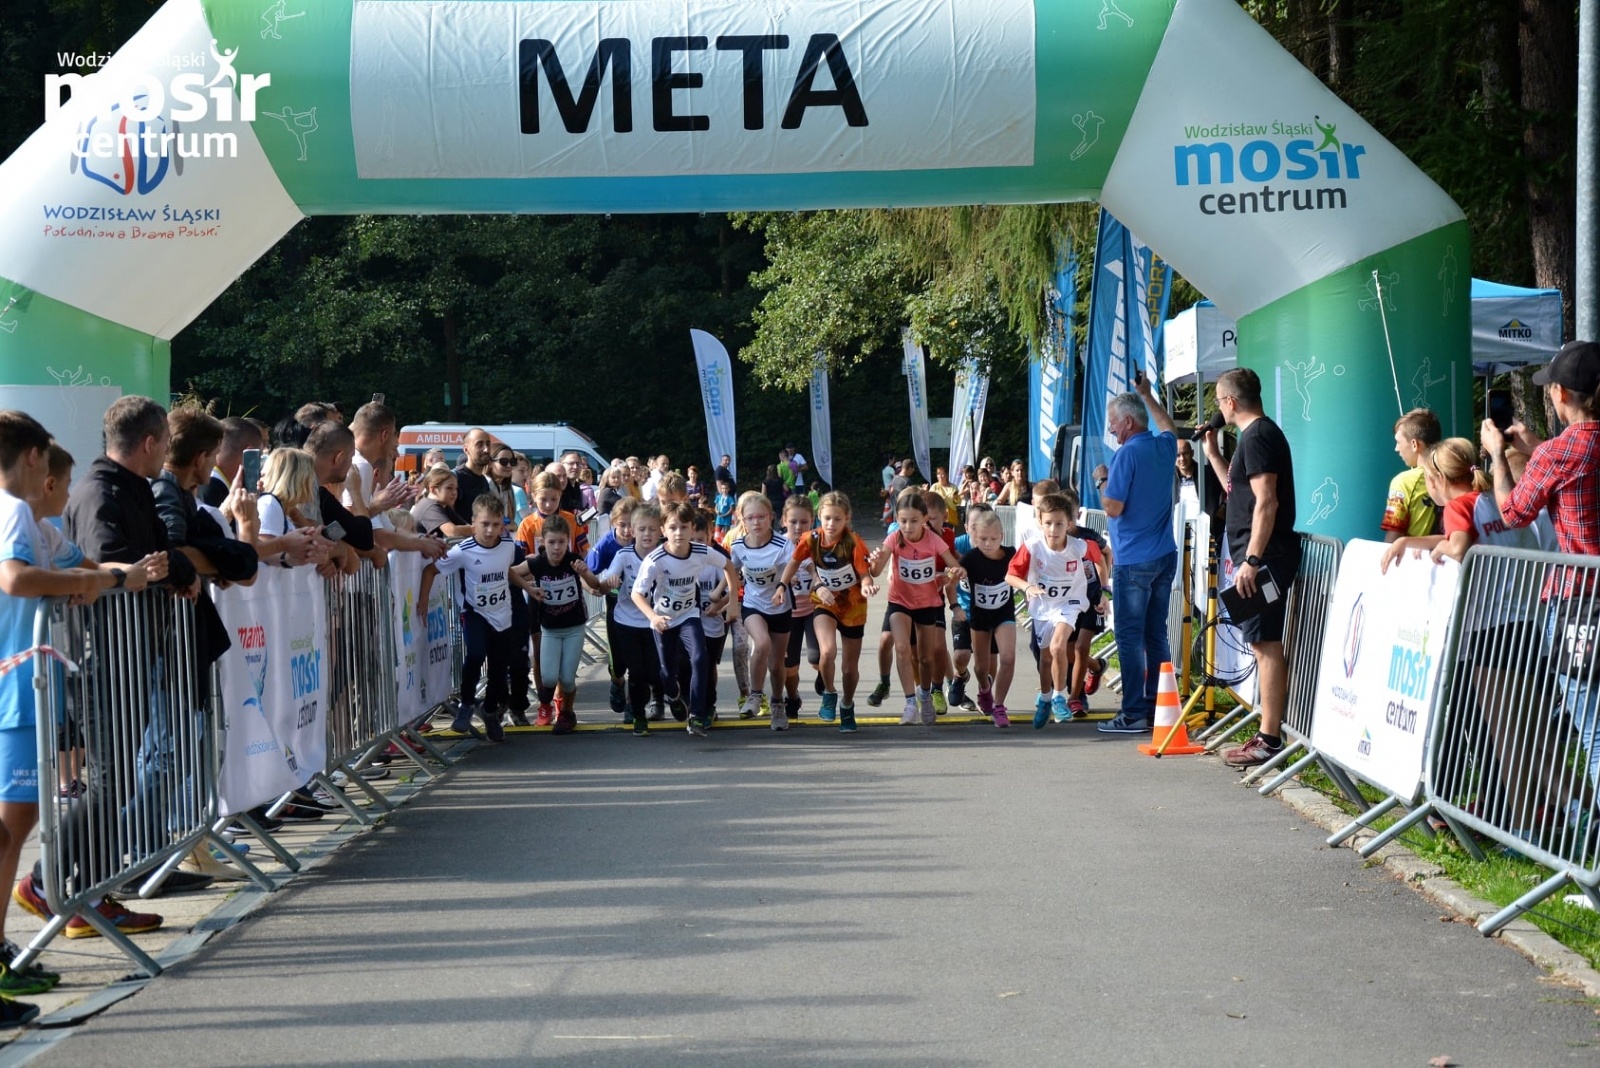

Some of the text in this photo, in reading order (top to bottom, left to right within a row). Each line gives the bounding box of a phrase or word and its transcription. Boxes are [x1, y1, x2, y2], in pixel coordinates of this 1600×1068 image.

[519, 33, 869, 134] META
[1184, 119, 1313, 139] Wodzisław Śląski
[1174, 140, 1366, 185] mosir
[1199, 185, 1347, 215] centrum
[43, 204, 221, 224] WODZISŁAW ŚLĄSKI
[1222, 329, 1238, 348] P
[1498, 328, 1532, 339] MITKO
[746, 573, 776, 585] 357
[821, 573, 853, 587] 353
[900, 566, 933, 580] 369
[668, 576, 694, 587] WATAHA
[477, 590, 506, 607] 364
[544, 586, 576, 600] 373
[977, 590, 1008, 605] 372
[661, 595, 693, 611] 365
[1388, 644, 1432, 701] mosir
